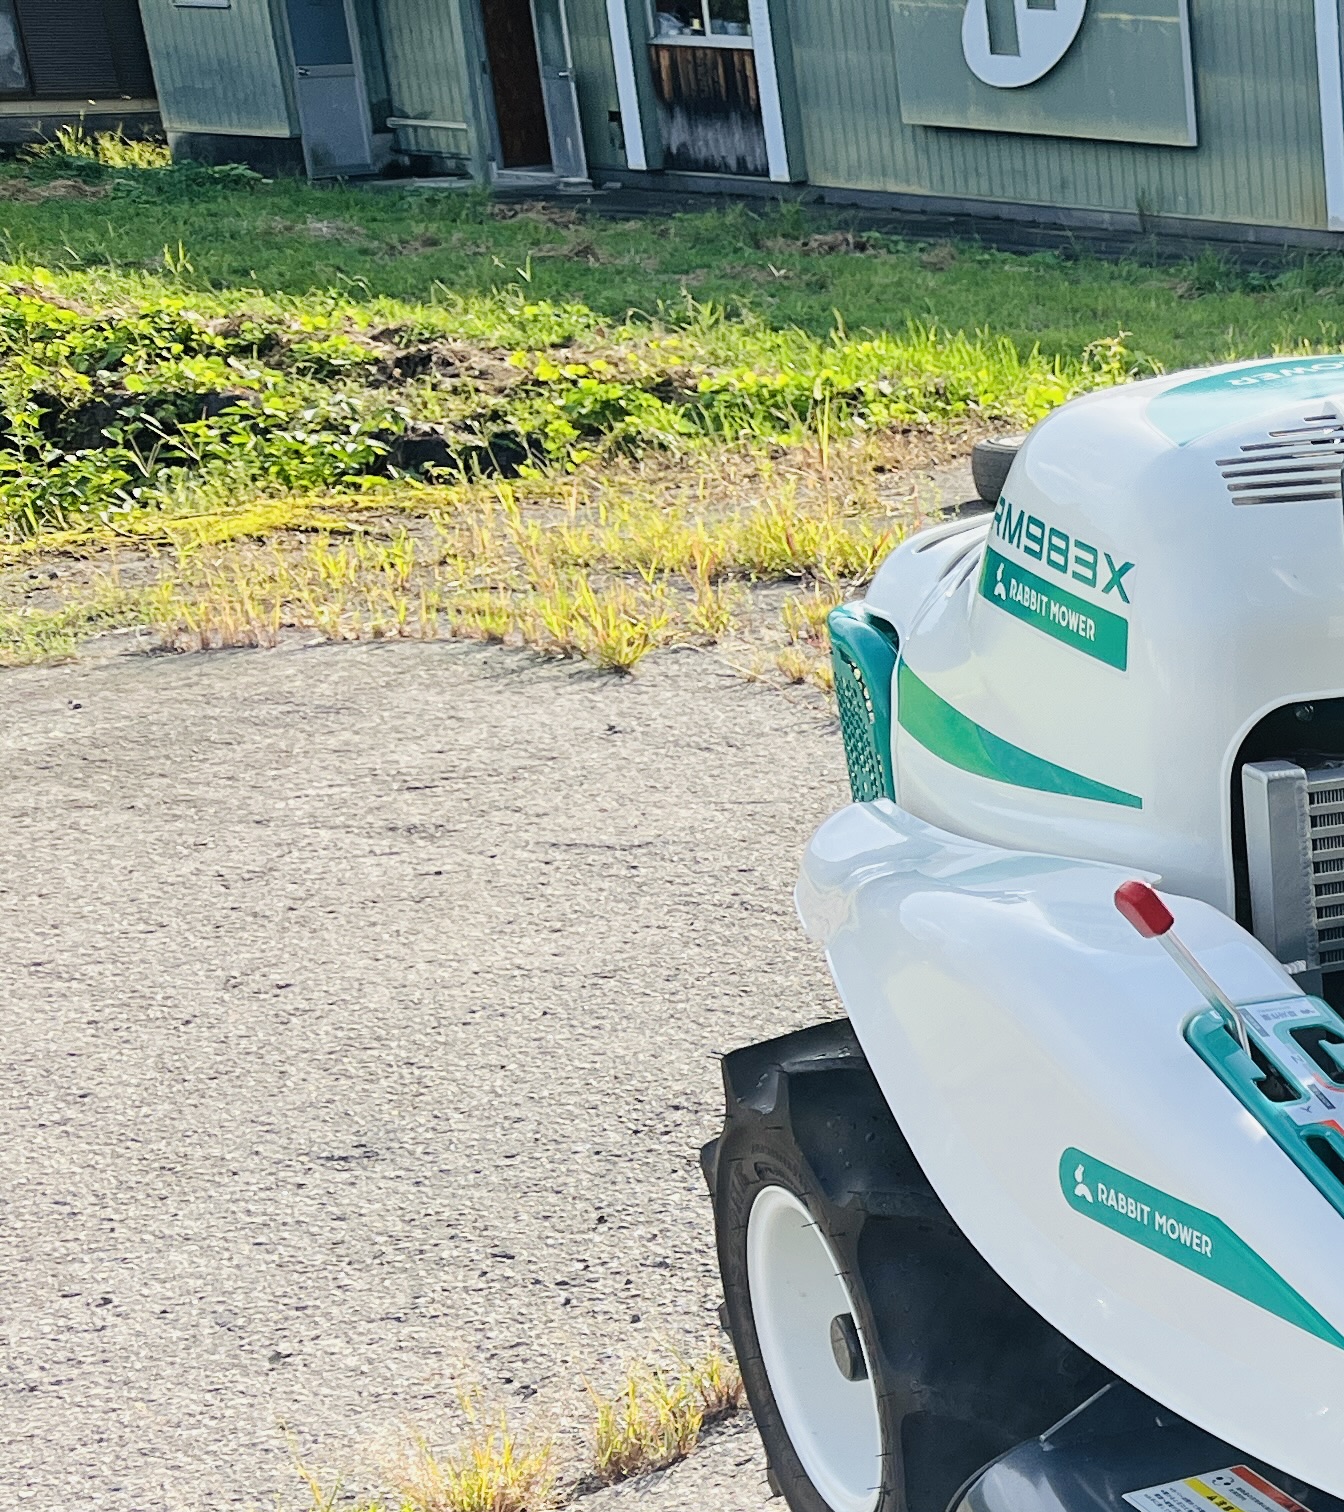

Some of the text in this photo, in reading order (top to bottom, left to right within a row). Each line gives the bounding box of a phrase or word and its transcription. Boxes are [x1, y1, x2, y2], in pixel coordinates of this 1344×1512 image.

[1009, 578, 1096, 642] RABBIT MOWER
[1097, 1182, 1213, 1258] RABBIT MOWER
